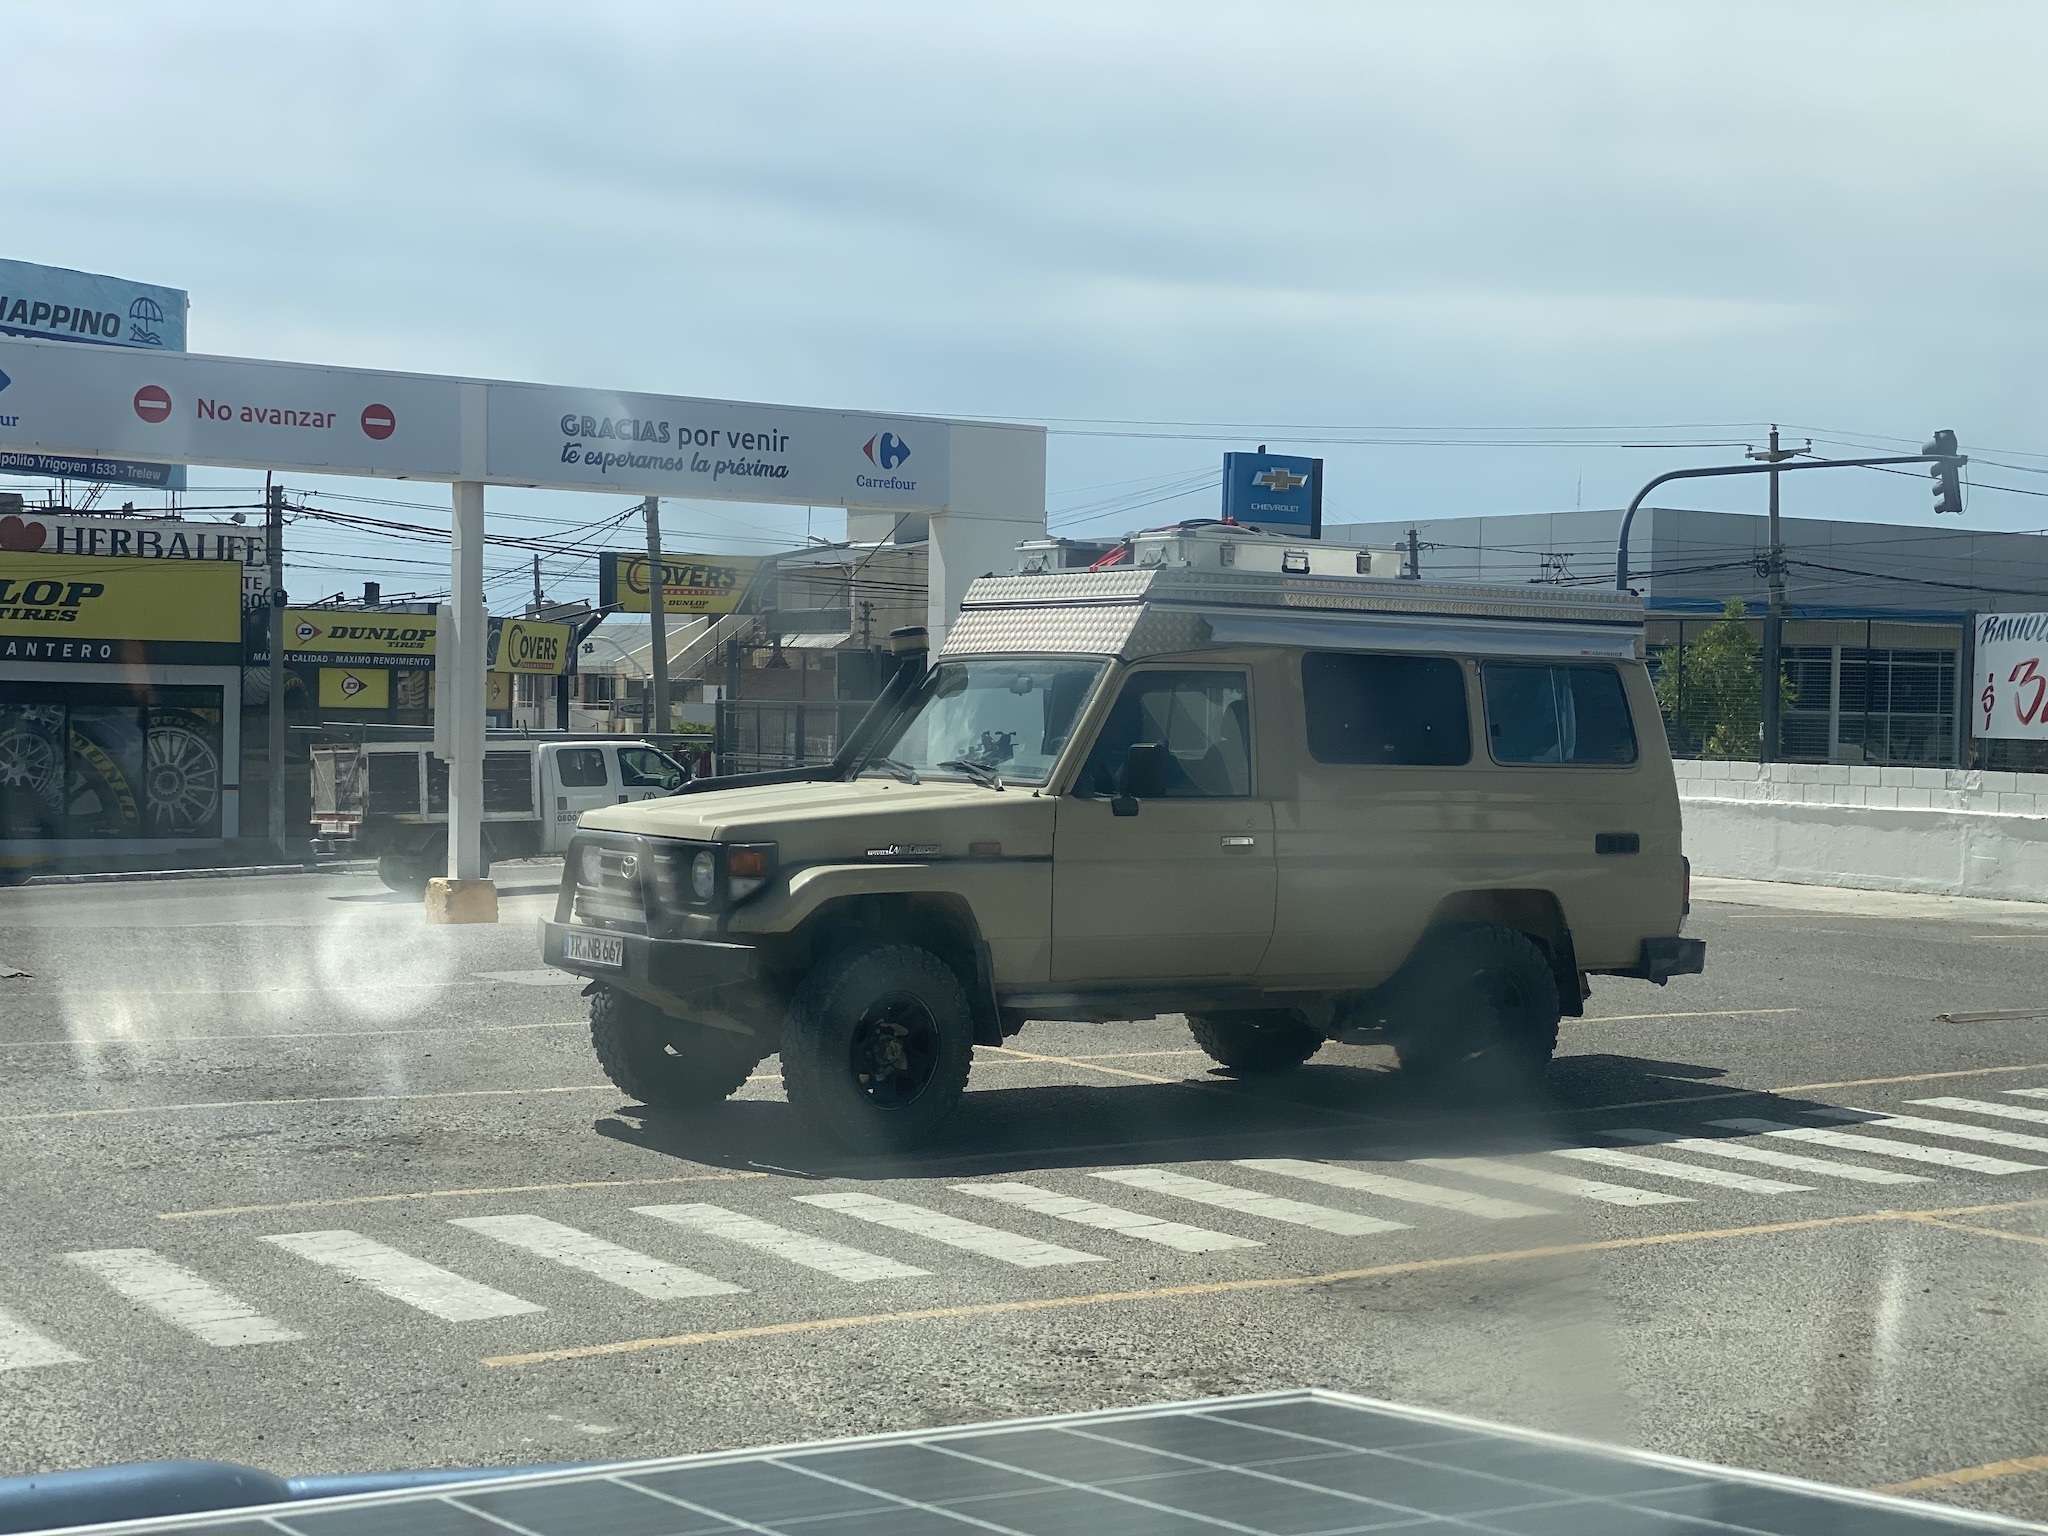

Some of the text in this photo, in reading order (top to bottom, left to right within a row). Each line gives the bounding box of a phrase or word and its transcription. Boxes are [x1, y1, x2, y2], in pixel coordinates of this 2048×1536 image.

[197, 398, 336, 429] No avanzar
[560, 413, 790, 452] GRACIAS por venir
[38, 456, 87, 474] Yrigoyen
[90, 462, 117, 475] 1533
[127, 465, 161, 480] Trelew
[561, 442, 790, 482] te esperamos la próxima
[856, 474, 917, 491] Carrefour
[1251, 503, 1300, 513] CHEVROLET
[328, 626, 436, 642] DUNLOP
[1978, 615, 2048, 647] RAVIOL
[5, 641, 111, 659] ANTERO
[387, 641, 425, 649] TIRES
[508, 624, 558, 668] COVERS
[292, 653, 328, 663] CALIDAD
[336, 655, 371, 665] MÁXIMO
[373, 656, 430, 667] RENDIMIENTO
[2008, 658, 2048, 725] 3
[602, 940, 622, 962] 667
